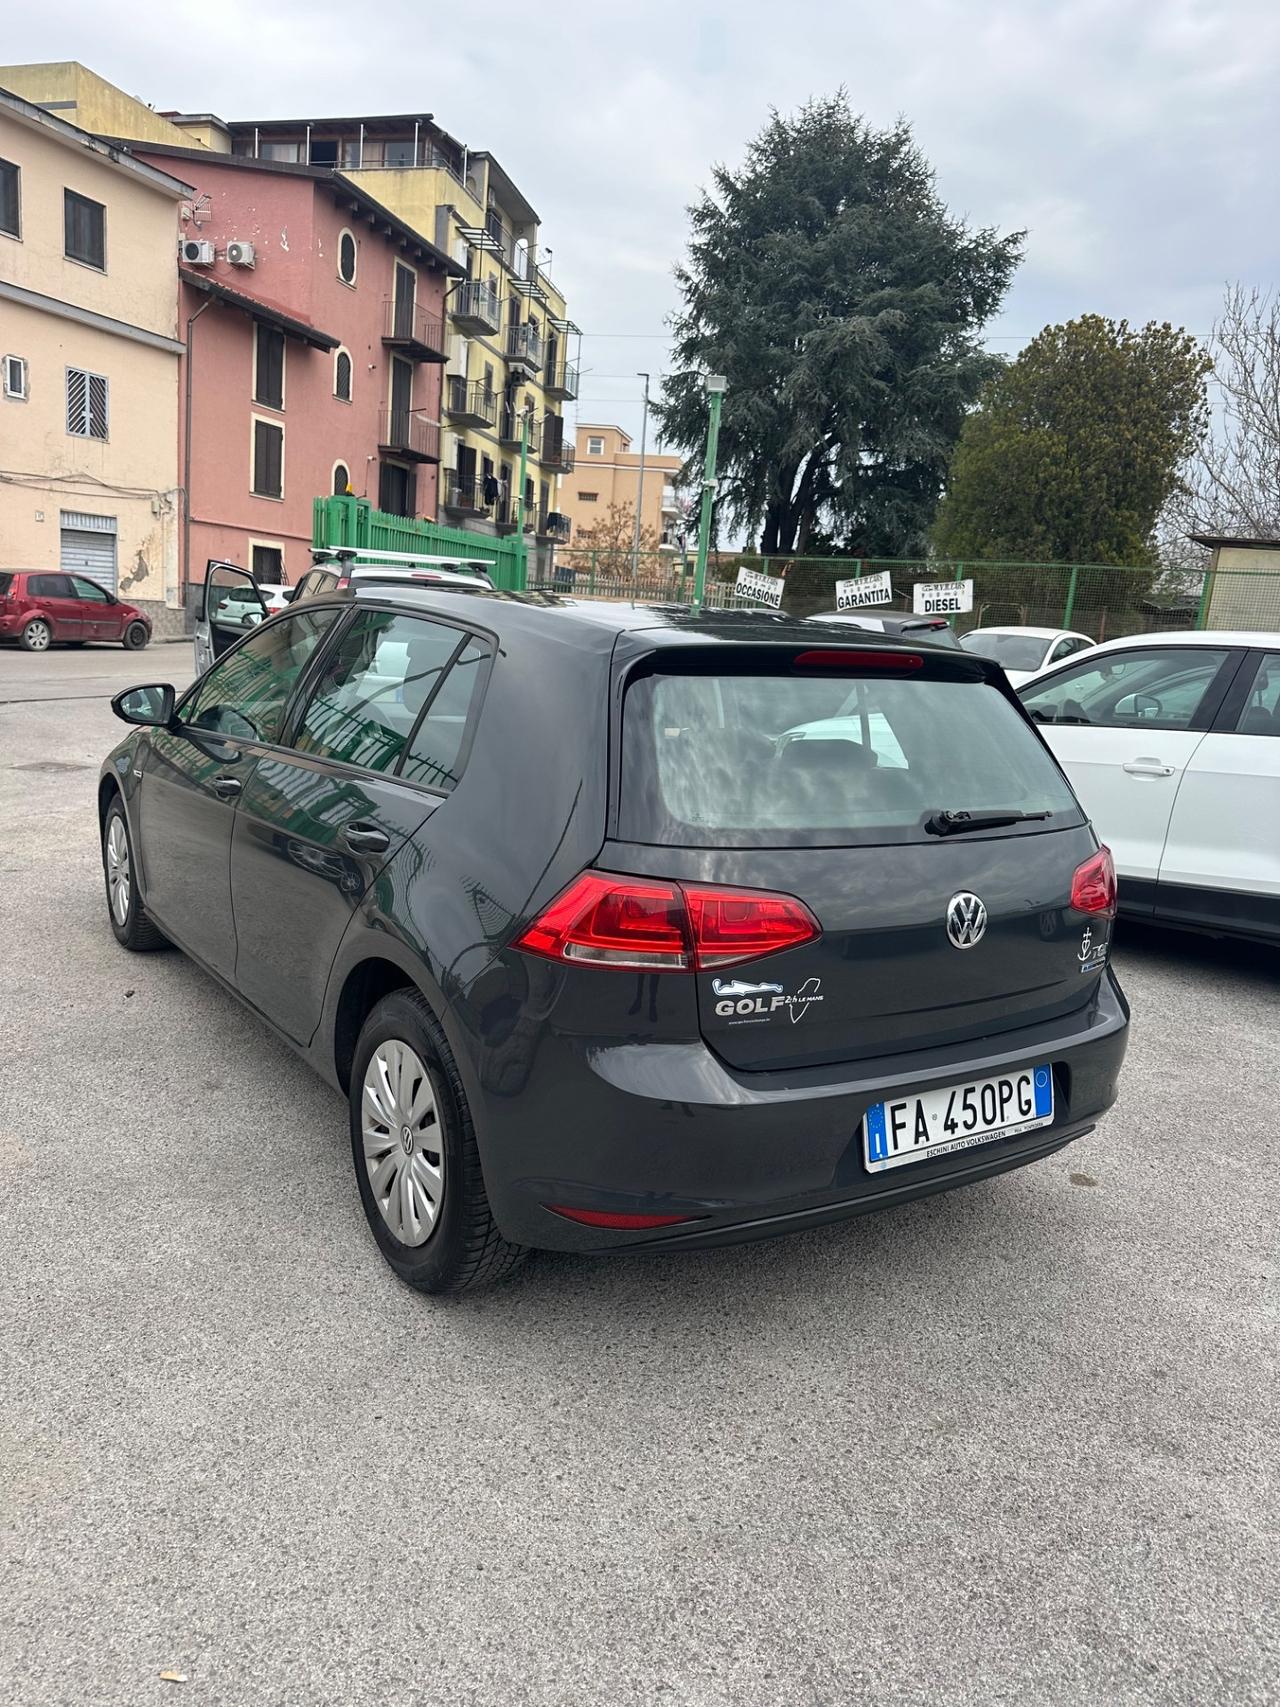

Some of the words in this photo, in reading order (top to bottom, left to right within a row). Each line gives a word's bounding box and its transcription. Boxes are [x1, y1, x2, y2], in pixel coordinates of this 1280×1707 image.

[736, 582, 780, 606] OCCASIONE
[838, 588, 891, 609] GARANTITA
[924, 598, 961, 613] DIESEL
[715, 996, 786, 1016] GOLF
[890, 1099, 930, 1150] FA
[943, 1075, 1032, 1135] 450PG
[926, 1145, 950, 1158] ESCHINI
[950, 1141, 966, 1152] AUTO
[966, 1131, 1006, 1147] VOLKSWAGEN
